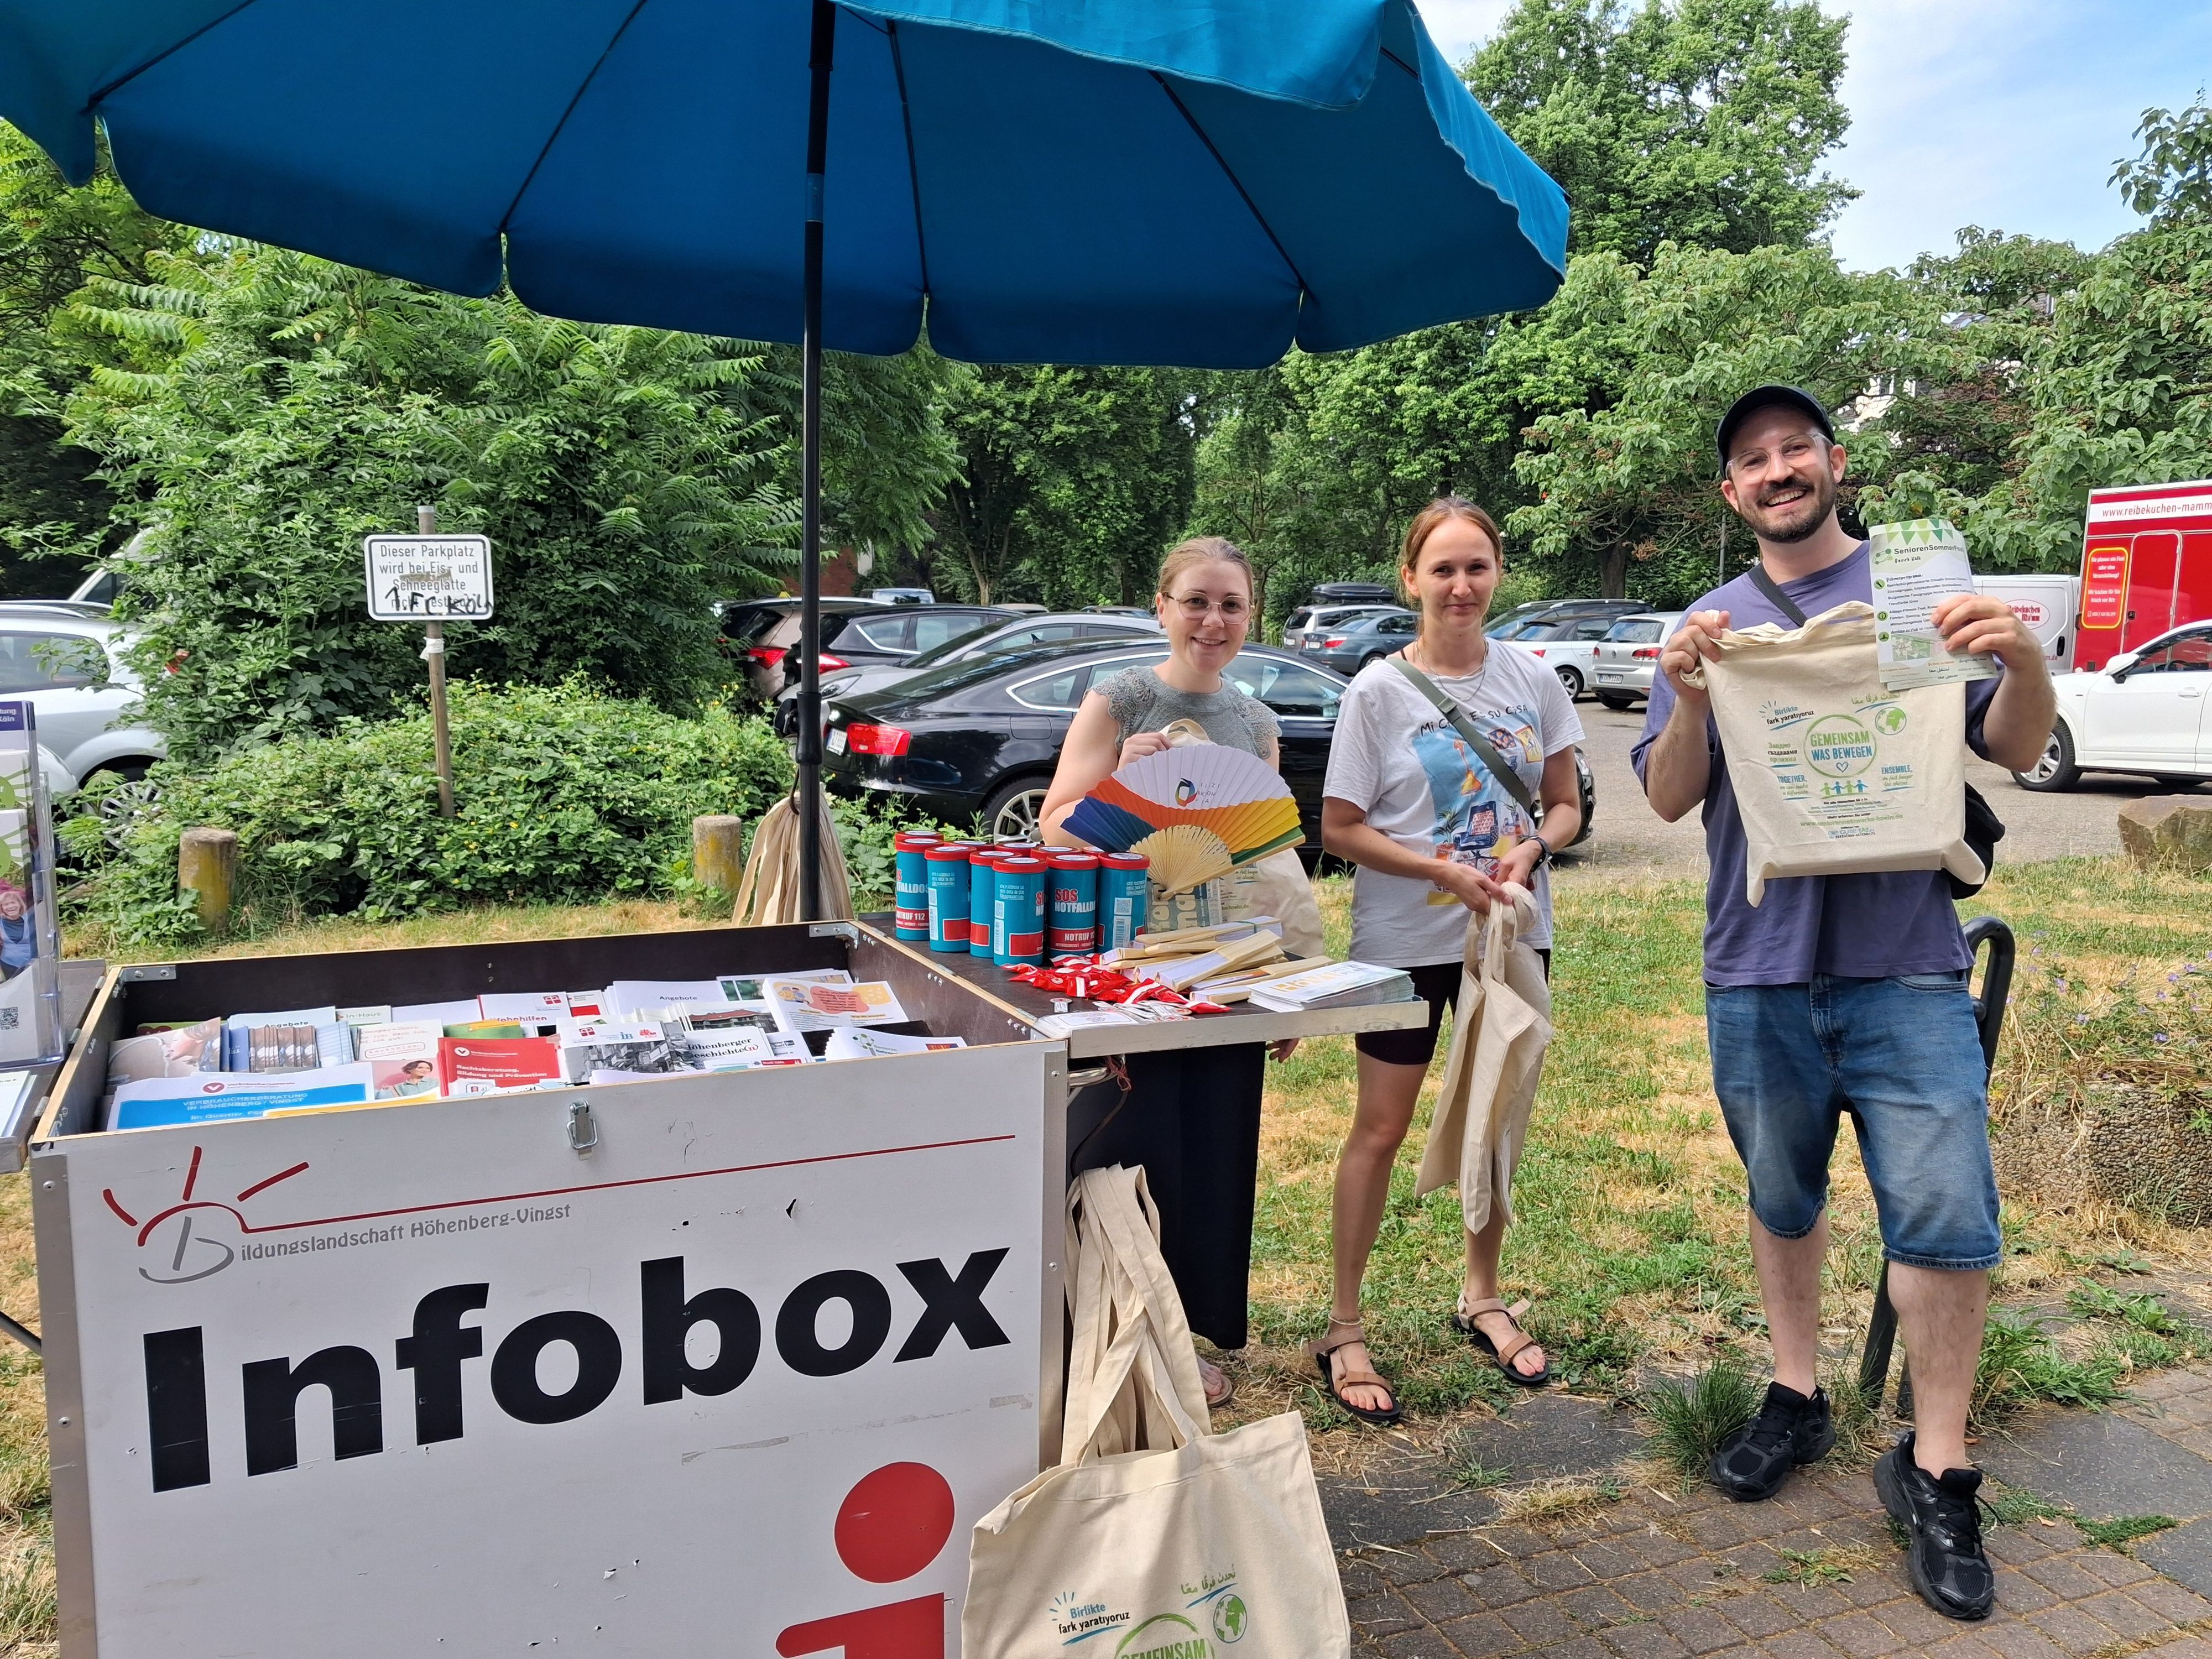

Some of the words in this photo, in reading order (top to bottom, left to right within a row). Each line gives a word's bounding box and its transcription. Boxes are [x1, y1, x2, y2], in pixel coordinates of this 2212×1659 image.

[380, 545, 415, 557] Dieser
[421, 545, 474, 561] Parkplatz
[379, 562, 404, 573] wird
[409, 562, 425, 573] bei
[430, 561, 452, 573] Eis-
[458, 561, 478, 573] und
[1488, 709, 1501, 719] SU
[1774, 706, 1798, 716] Birlikte
[1780, 711, 1815, 723] yaratıyoruz
[1810, 730, 1870, 747] GEMEINSAM
[1811, 749, 1830, 761] WAS
[1833, 745, 1872, 760] BEWEGEN
[1055, 888, 1078, 902] SOS
[914, 912, 925, 921] 112
[1065, 932, 1089, 942] NOTRUF
[691, 1044, 759, 1058] eschichte(n)
[183, 1093, 307, 1106] VERBRAUCHERBERATUNG
[411, 1203, 571, 1239] Höhenberg-Vingst
[143, 1246, 1013, 1493] Infobox
[1070, 1603, 1106, 1619] Birlikte
[1058, 1623, 1077, 1634] fark
[1079, 1611, 1130, 1632] yaratıyoruz
